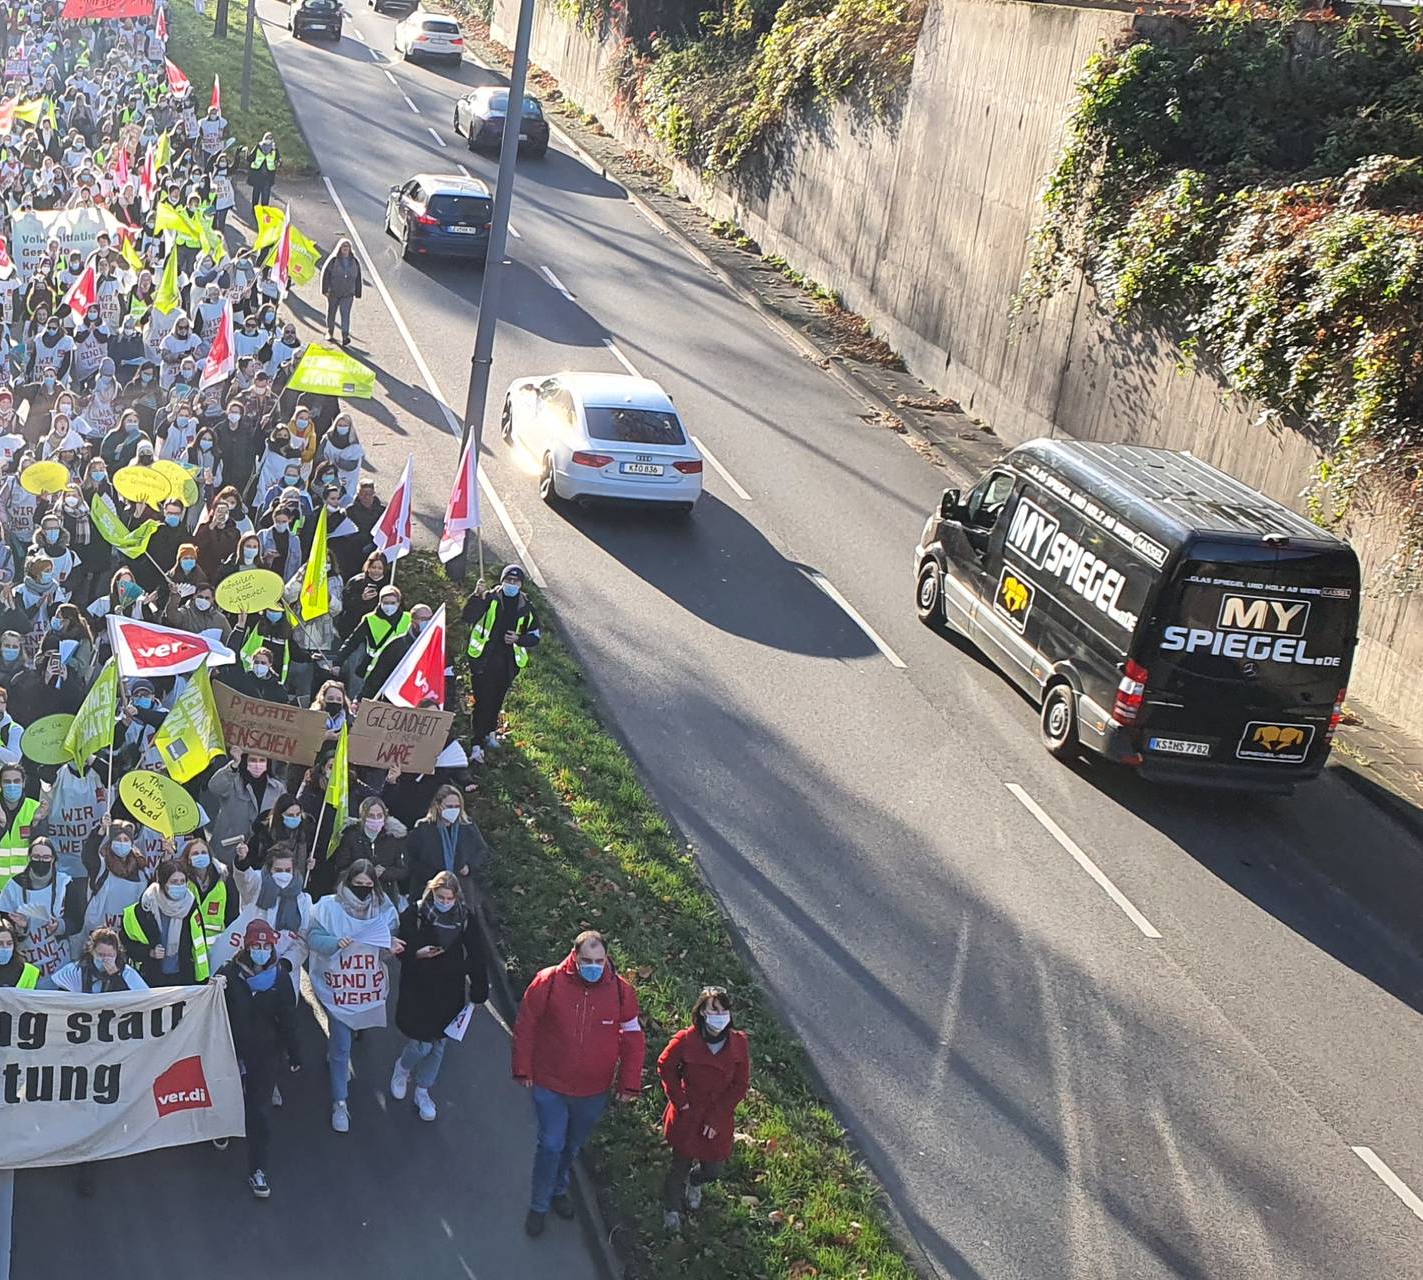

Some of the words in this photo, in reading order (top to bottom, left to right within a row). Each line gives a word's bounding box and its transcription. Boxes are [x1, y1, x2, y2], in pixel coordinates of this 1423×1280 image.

[1009, 503, 1056, 560] MY
[1134, 538, 1166, 562] KASSEL
[1220, 597, 1305, 632] MY
[366, 706, 442, 737] GESUNDHEIT
[377, 742, 415, 765] WARE
[132, 777, 166, 810] Working
[150, 775, 164, 791] The
[61, 806, 94, 822] WIR
[133, 798, 163, 821] Dead
[48, 824, 87, 837] SIND
[339, 954, 375, 970] WIR
[324, 971, 367, 989] SIND
[158, 1088, 206, 1104] ver.di
